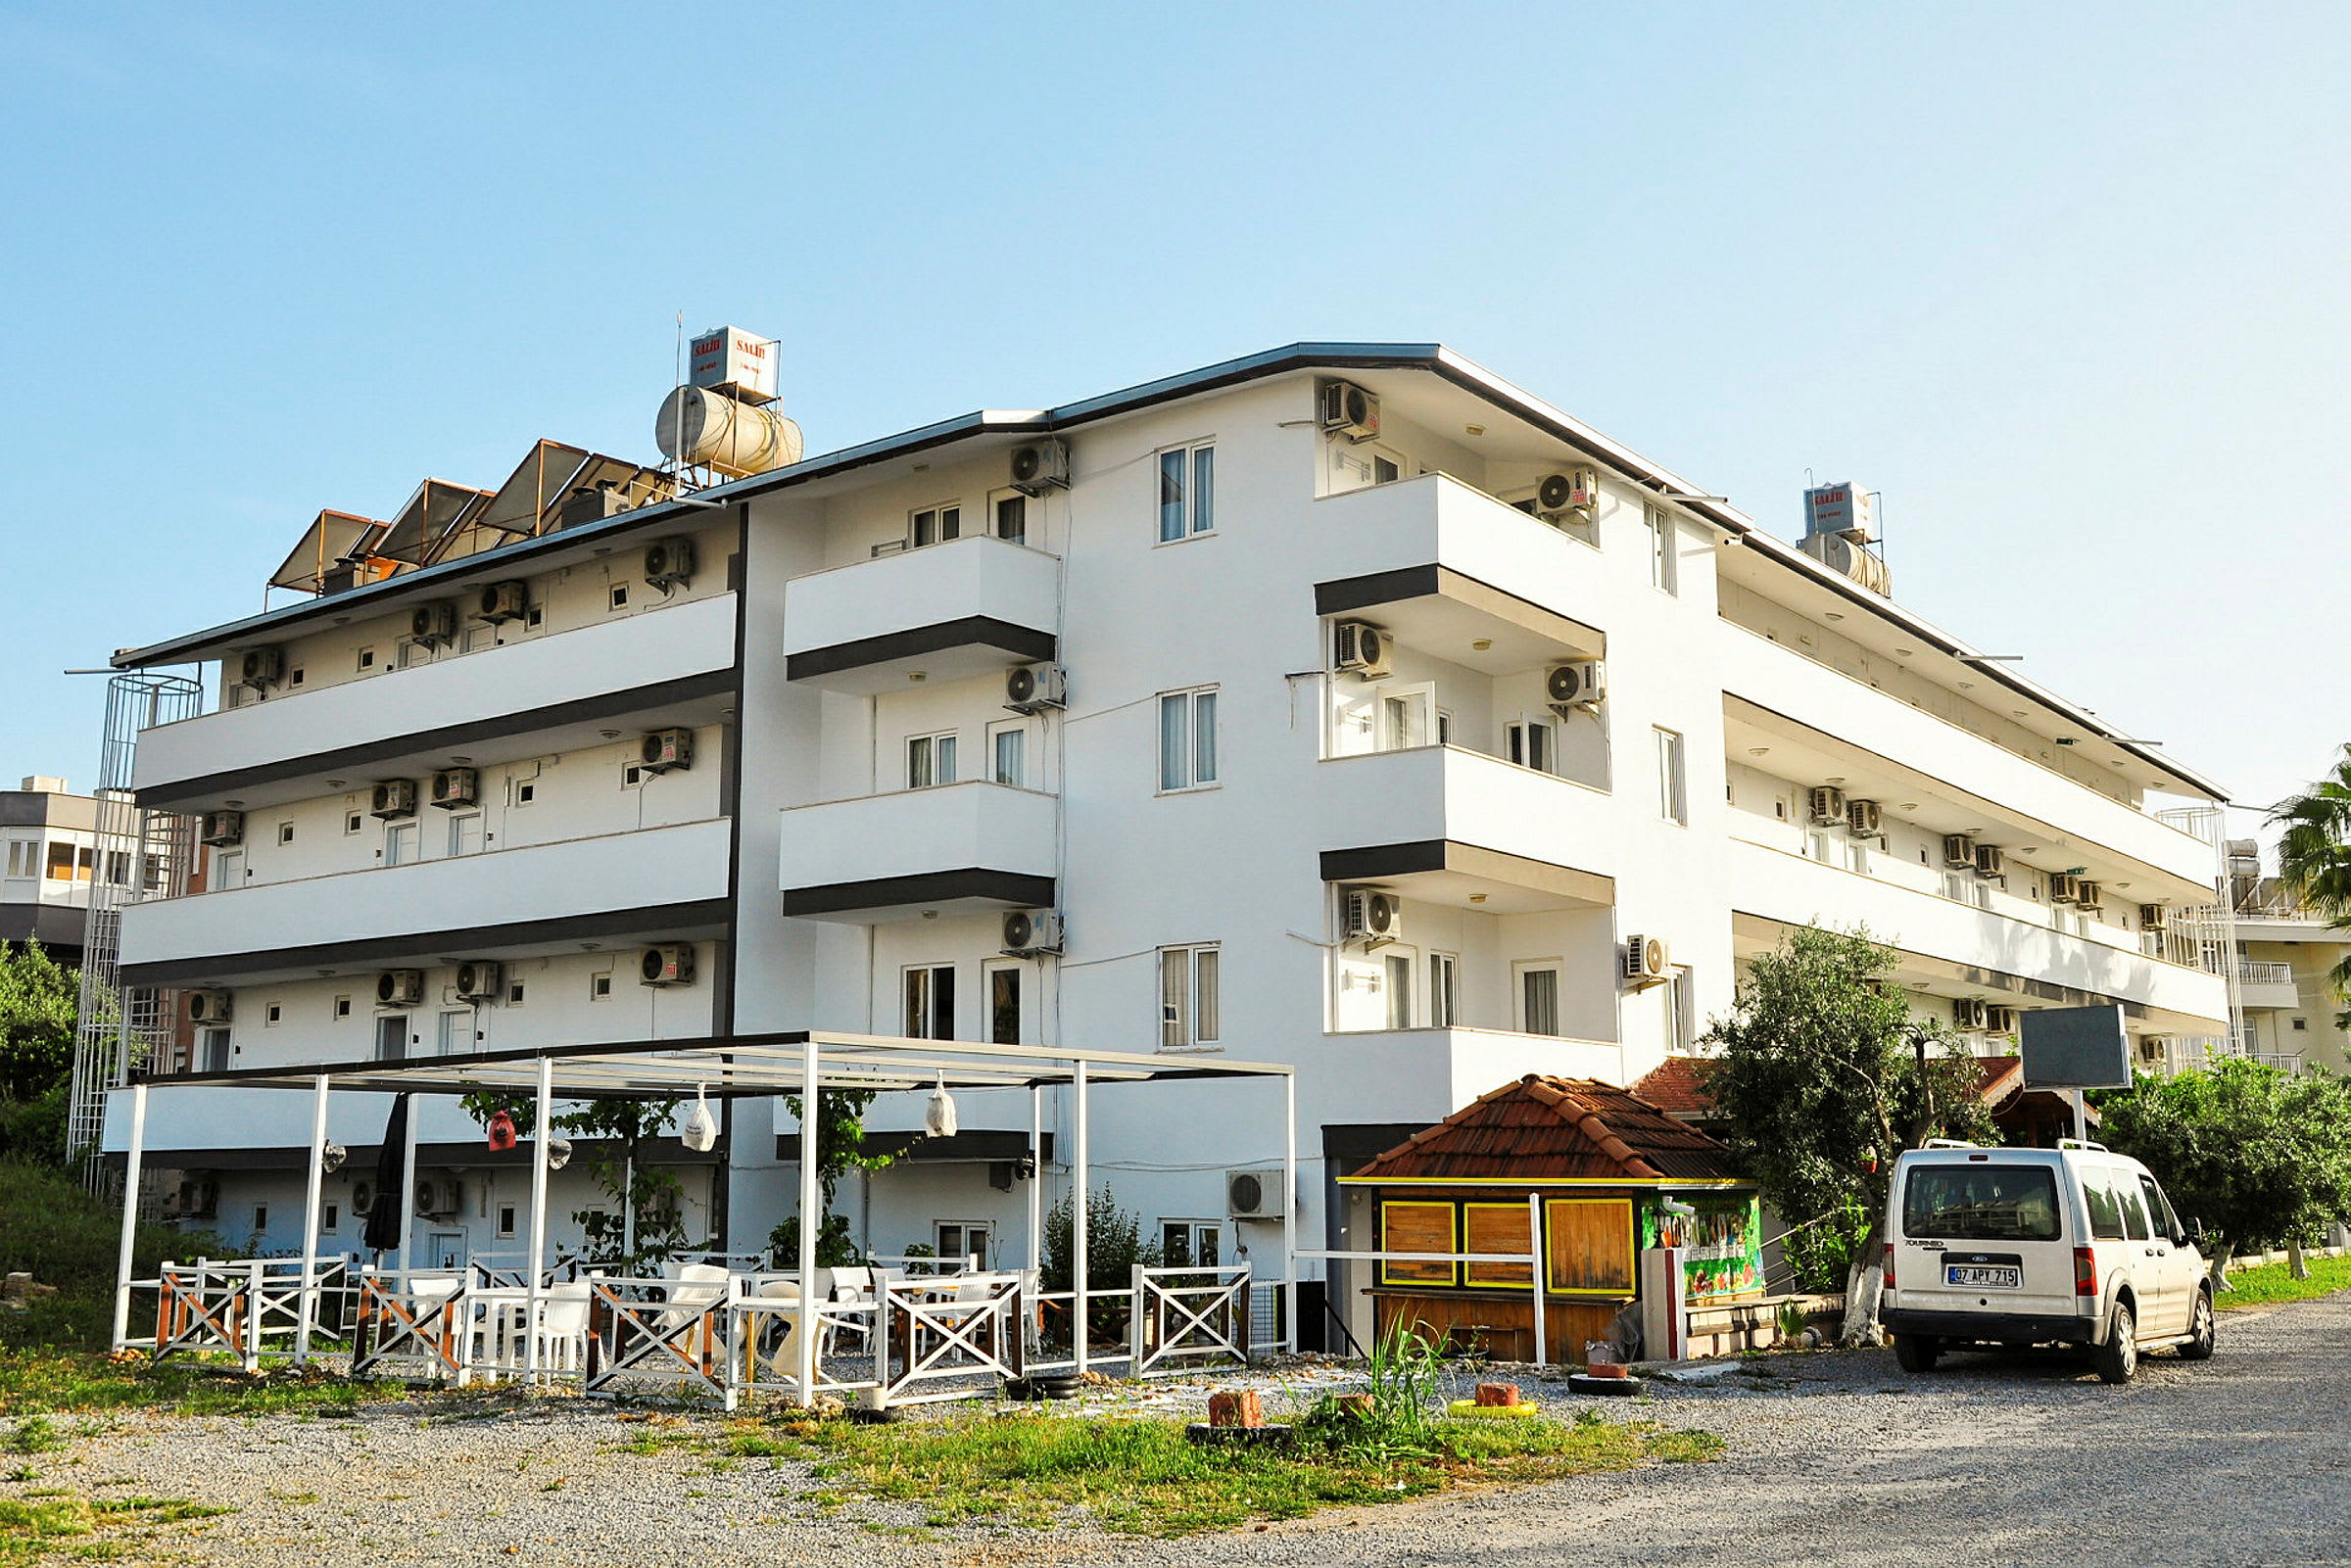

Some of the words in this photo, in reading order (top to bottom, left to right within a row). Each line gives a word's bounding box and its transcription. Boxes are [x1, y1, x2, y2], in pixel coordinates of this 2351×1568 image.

[1955, 1269, 1968, 1280] 07
[1972, 1269, 1991, 1281] APY
[1995, 1270, 2015, 1282] 715
